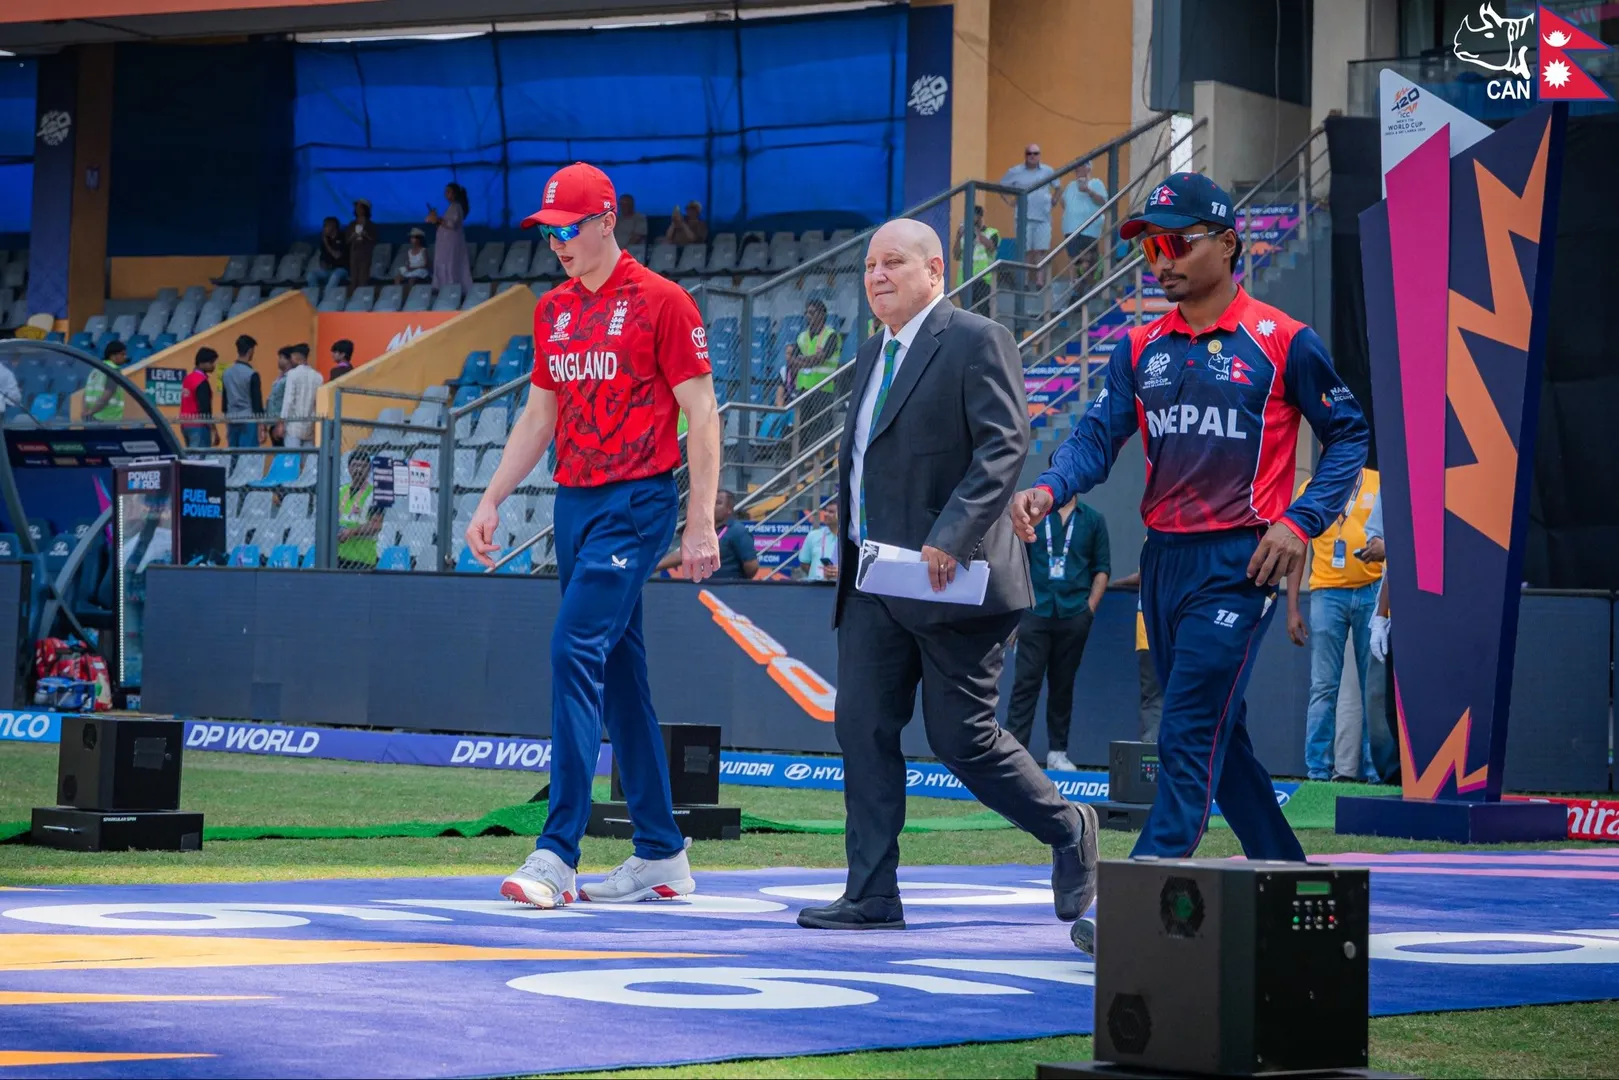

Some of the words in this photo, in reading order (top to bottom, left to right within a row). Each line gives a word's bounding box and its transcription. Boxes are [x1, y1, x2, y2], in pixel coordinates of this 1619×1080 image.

[1387, 123, 1410, 131] WORLD
[1410, 120, 1424, 128] CUP
[151, 369, 177, 381] LEVEL
[177, 370, 183, 381] 1
[549, 352, 617, 383] ENGLAND
[1215, 373, 1229, 382] CAN
[1146, 404, 1247, 440] NEPAL
[128, 470, 161, 481] POWER
[183, 488, 208, 503] FUEL
[186, 724, 221, 748] DP
[226, 727, 320, 754] WORLD
[450, 740, 493, 764] DP
[719, 760, 775, 777] YUNDAI
